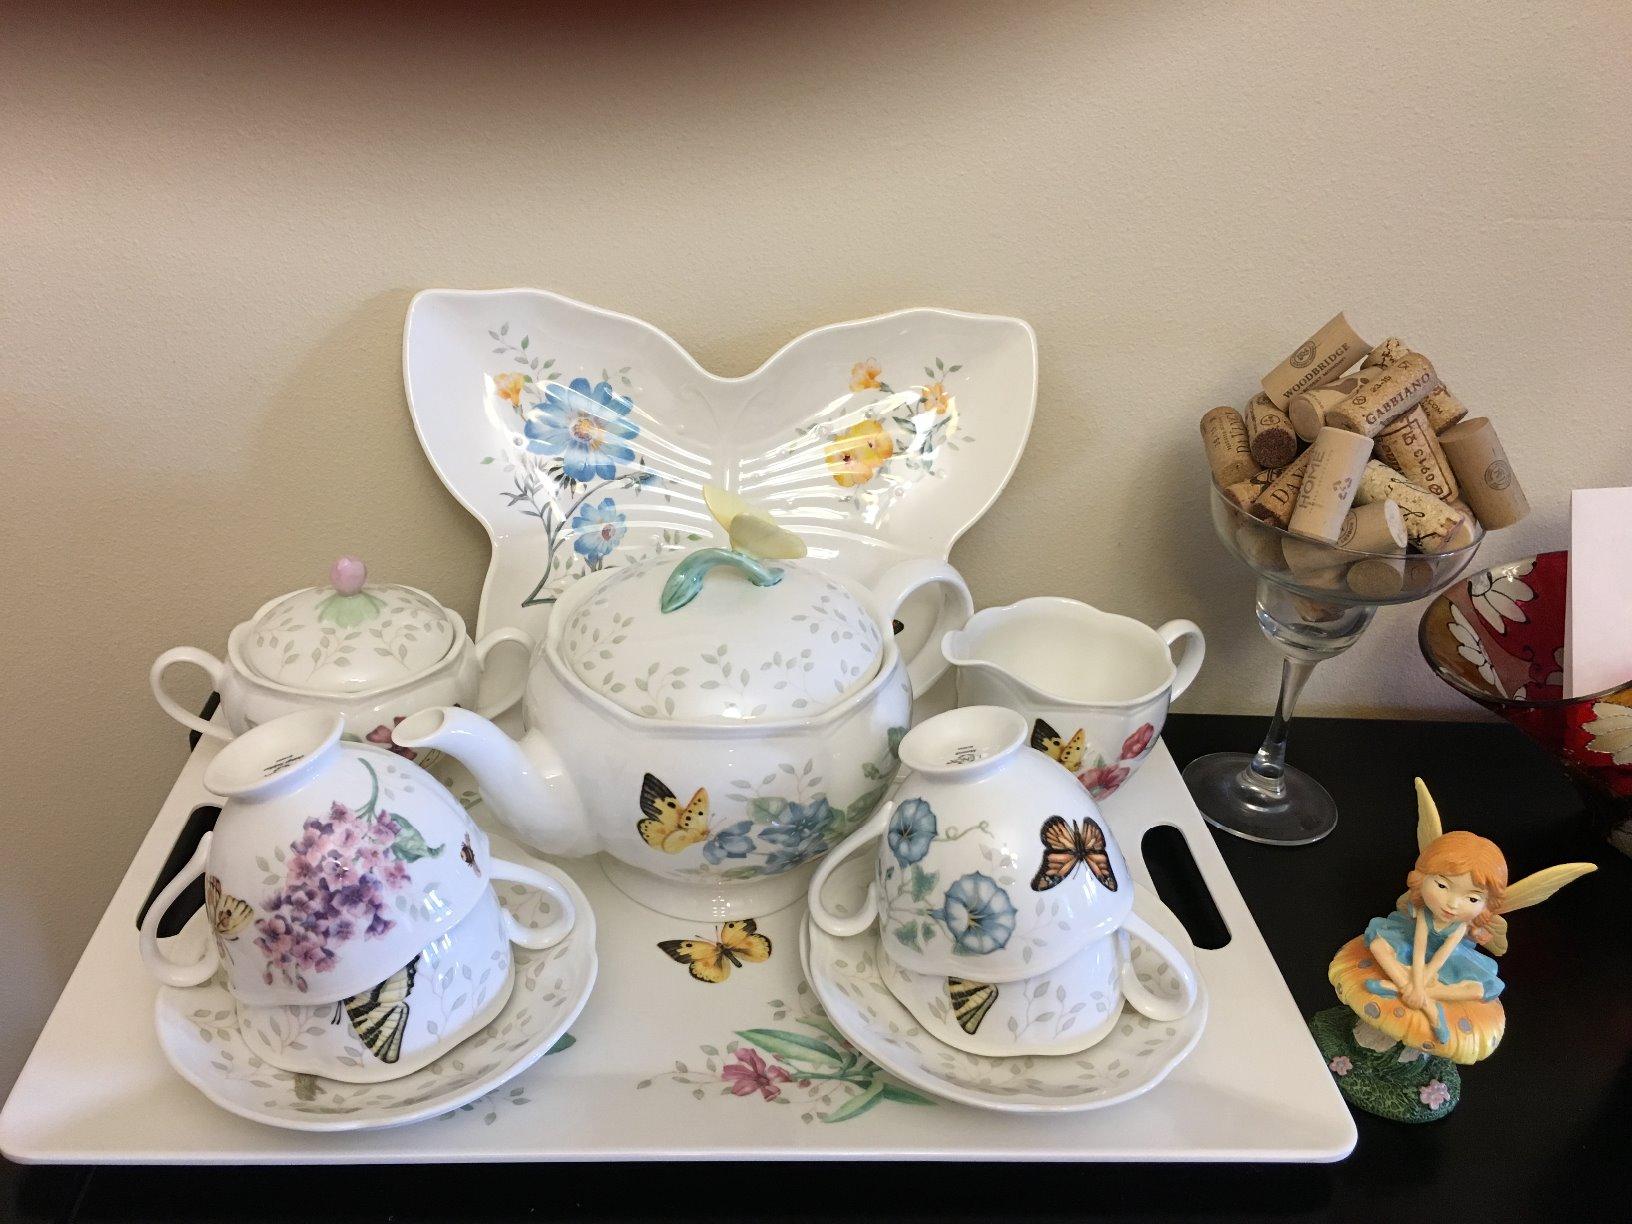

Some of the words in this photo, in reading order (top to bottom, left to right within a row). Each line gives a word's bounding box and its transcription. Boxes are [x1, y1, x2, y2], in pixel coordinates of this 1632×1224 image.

[1282, 342, 1351, 400] WOODBRIDGE
[1365, 372, 1431, 425] GABBIANO
[1299, 451, 1325, 508] HOME
